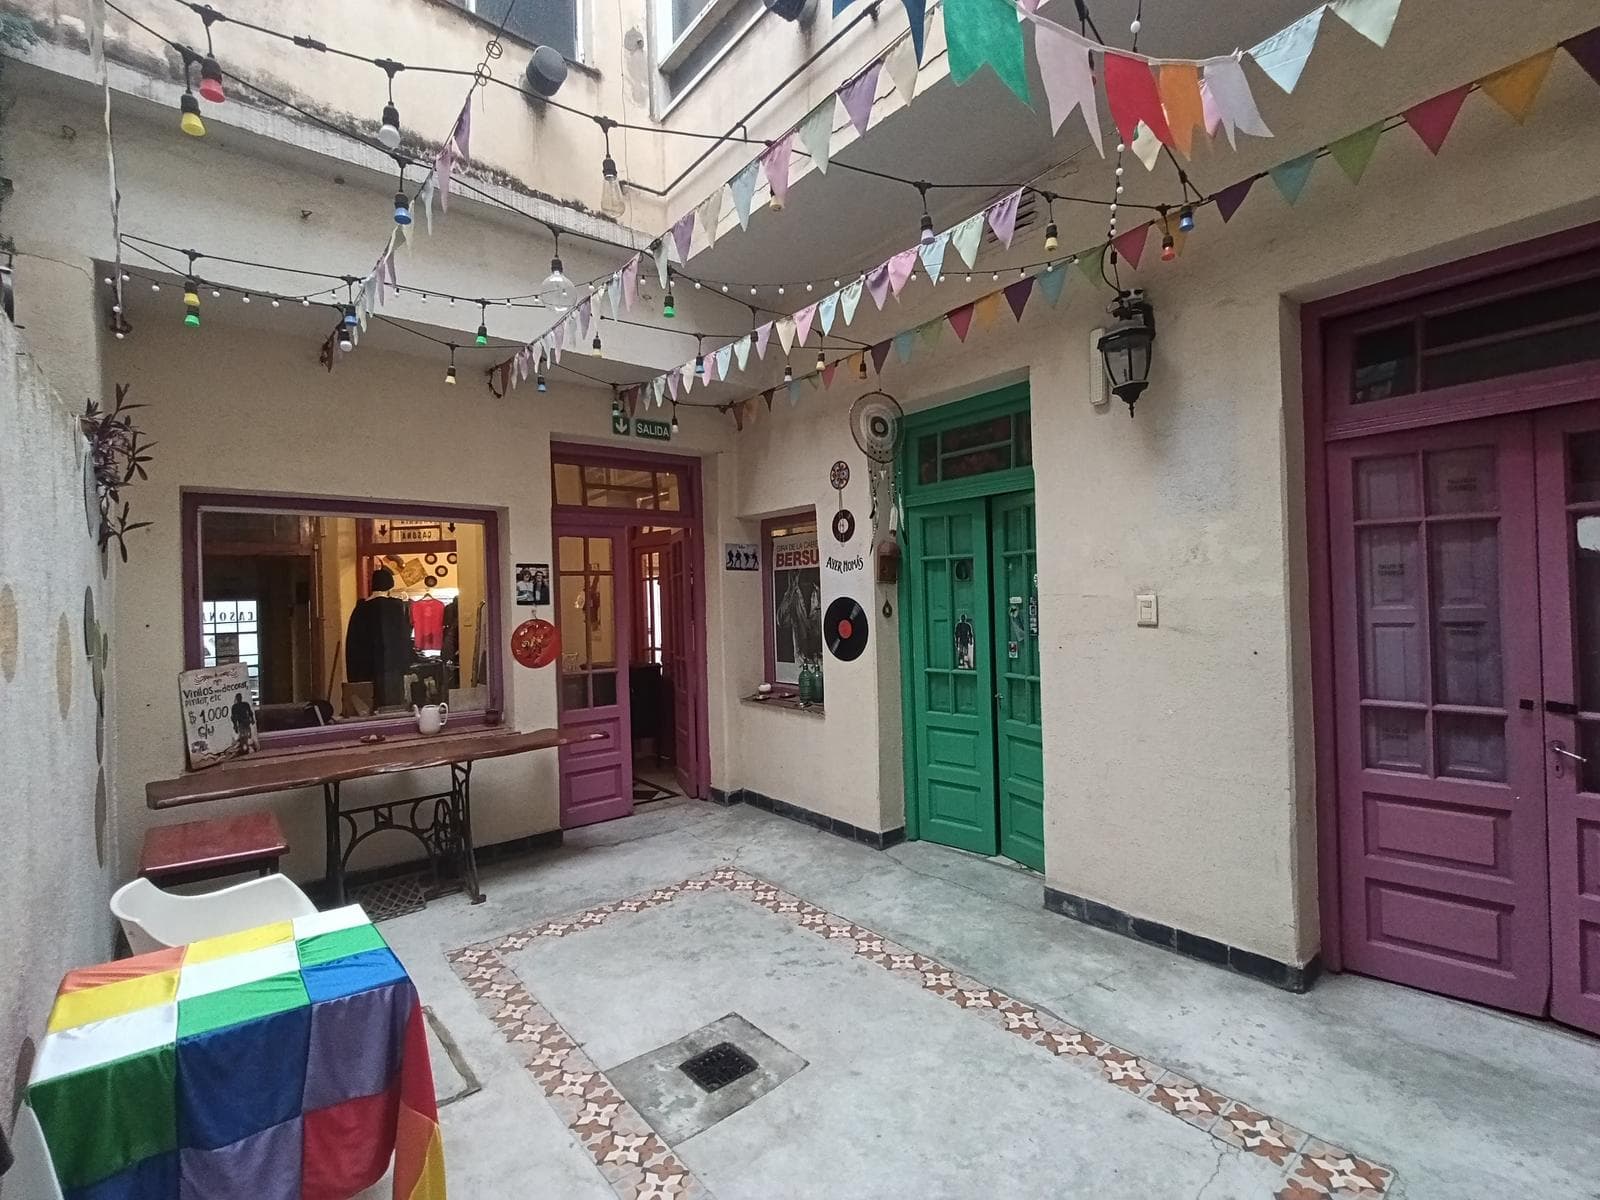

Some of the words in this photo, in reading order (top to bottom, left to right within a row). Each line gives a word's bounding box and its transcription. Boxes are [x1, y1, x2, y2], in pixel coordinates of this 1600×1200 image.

[637, 423, 669, 436] SALIDA
[826, 556, 843, 574] AYER
[183, 686, 213, 699] Vinilos
[210, 694, 221, 702] etc
[189, 711, 196, 725] $
[200, 706, 229, 723] 1.000
